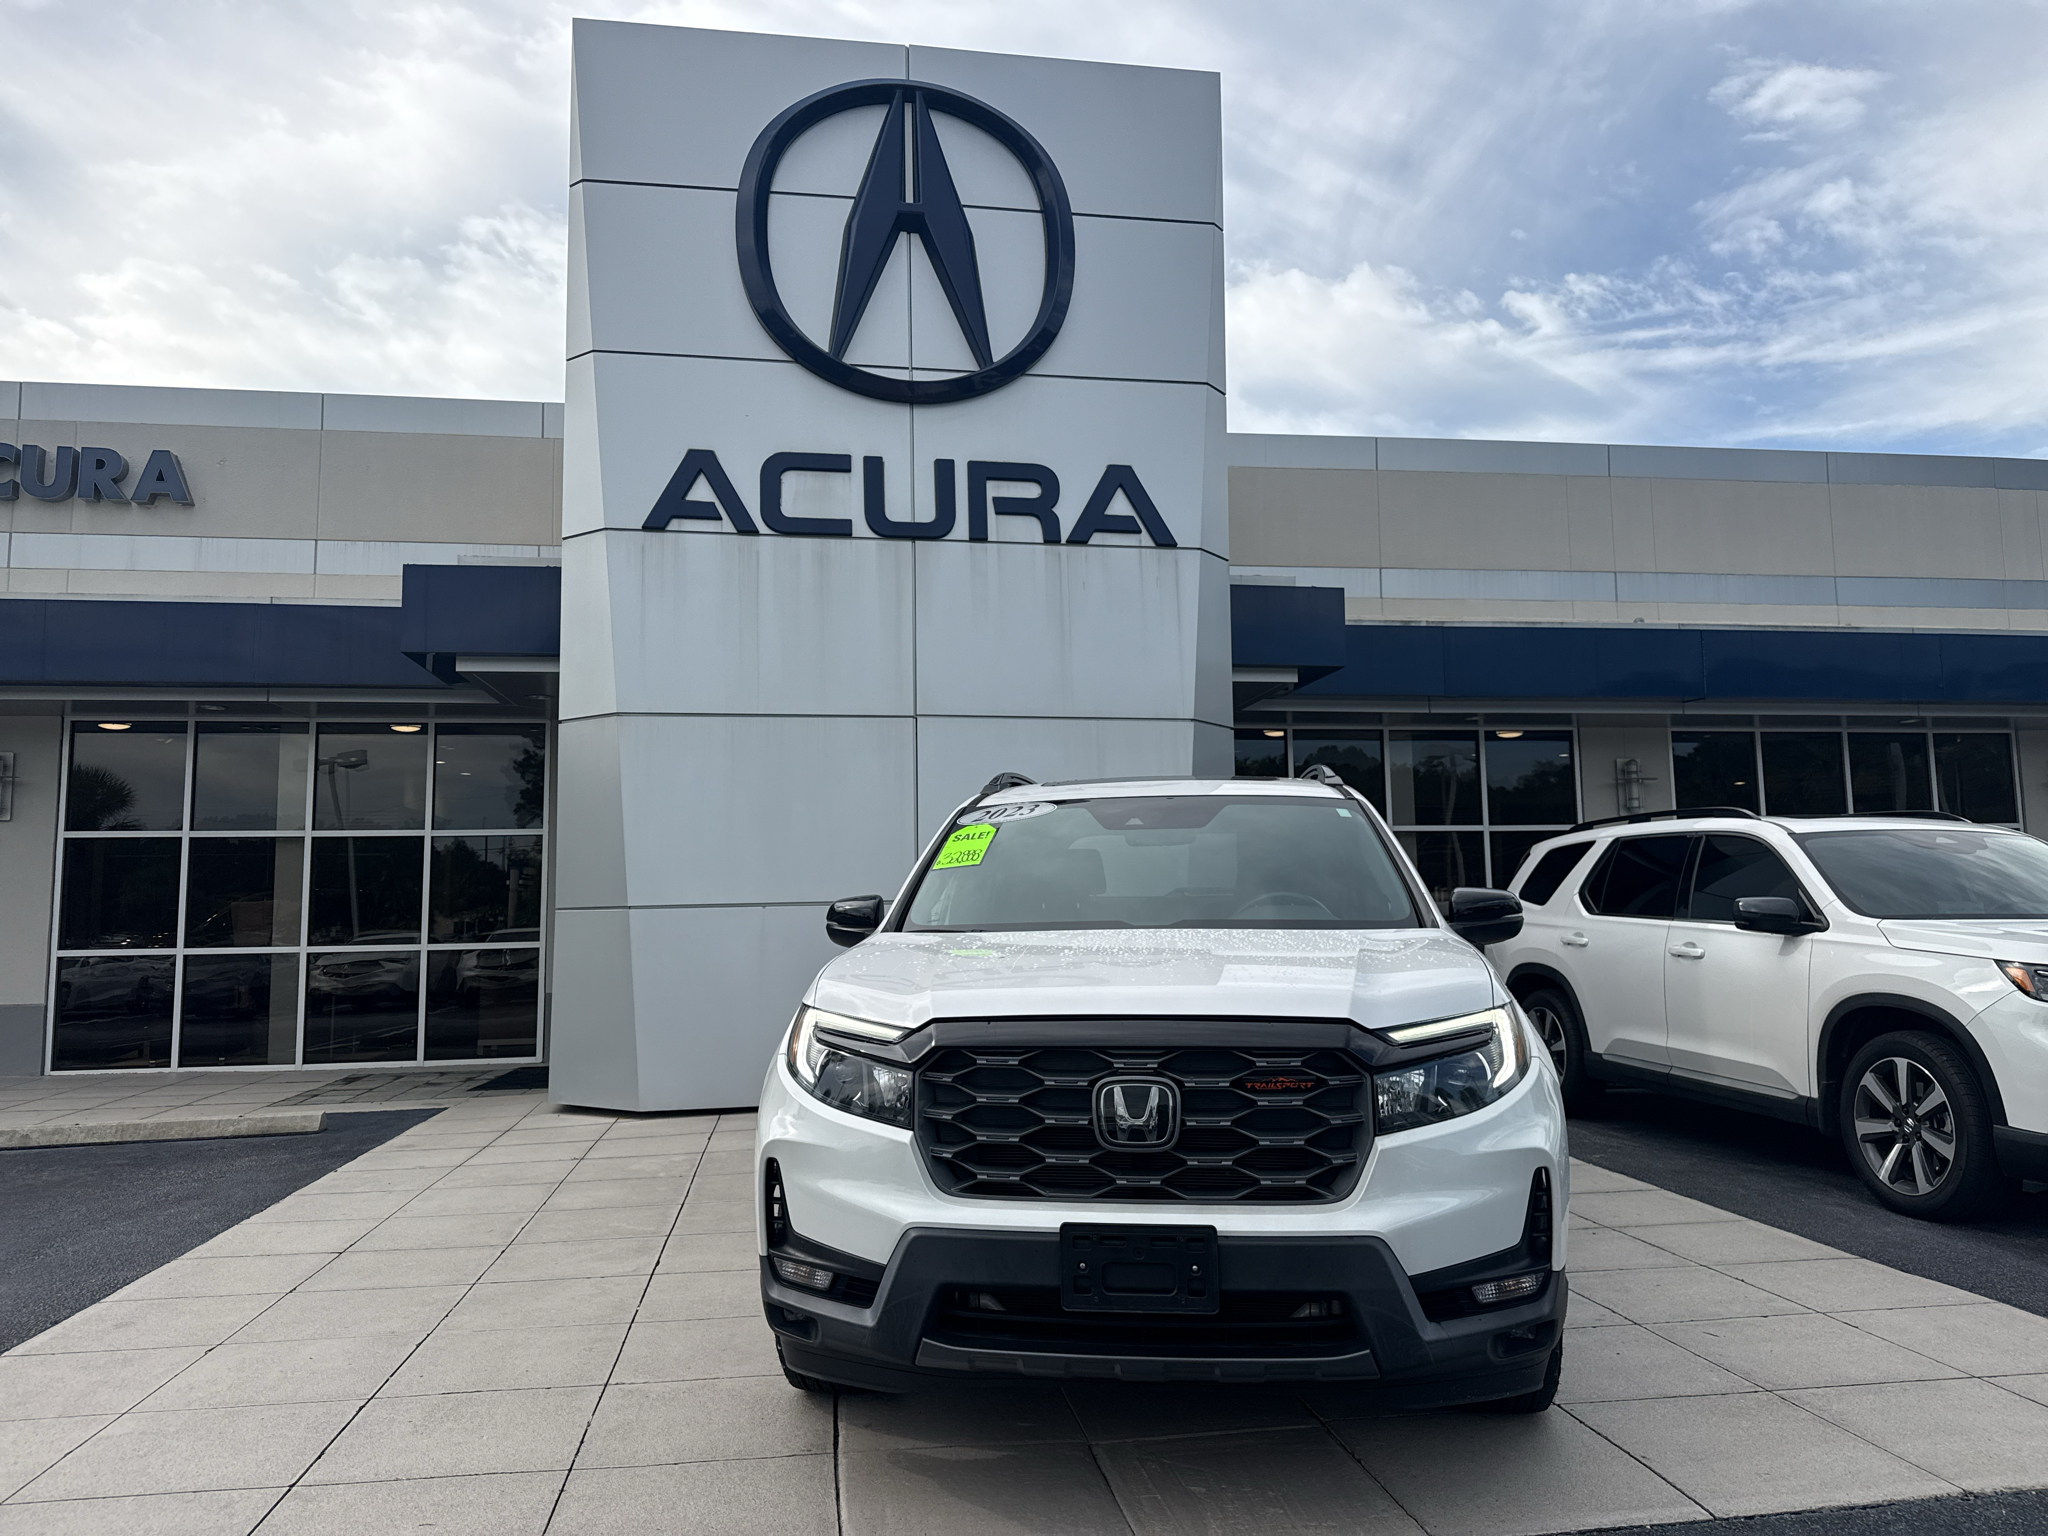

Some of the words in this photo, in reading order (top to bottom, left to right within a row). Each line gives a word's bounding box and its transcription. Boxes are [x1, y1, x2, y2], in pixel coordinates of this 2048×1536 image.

[642, 448, 1178, 547] ACURA
[971, 804, 1040, 823] 2023
[952, 831, 990, 842] SALE!
[1245, 1082, 1315, 1090] TRAILSPORT
